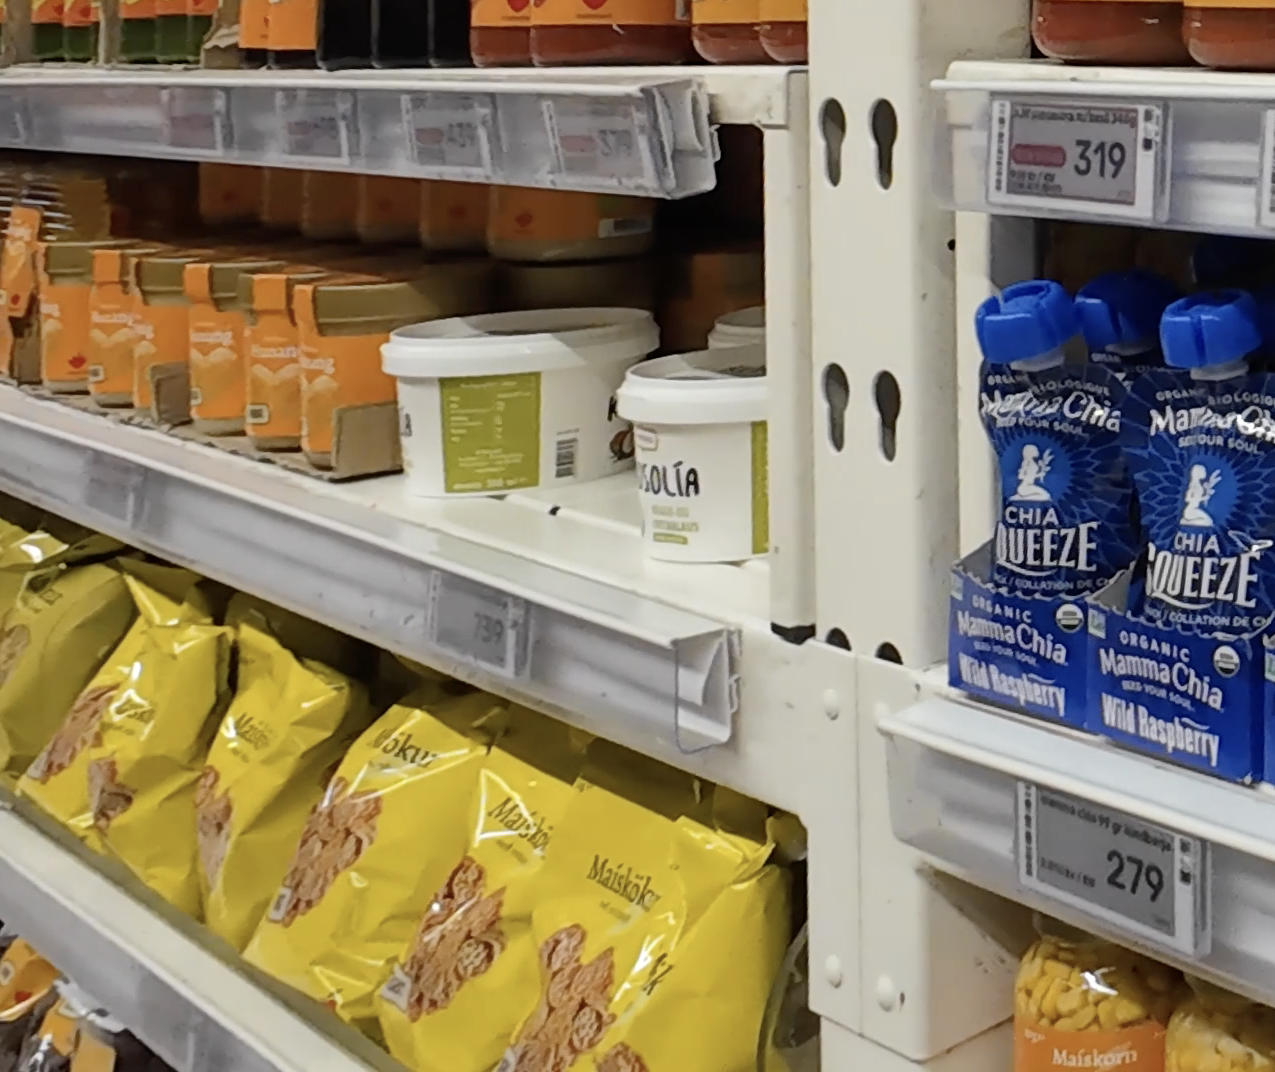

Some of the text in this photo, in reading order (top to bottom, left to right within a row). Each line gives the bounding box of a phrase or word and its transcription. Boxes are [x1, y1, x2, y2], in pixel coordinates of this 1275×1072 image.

[1073, 139, 1127, 180] 319
[1005, 505, 1059, 527] CHIA
[994, 520, 1099, 578] QUEEZE
[1173, 531, 1221, 556] CHIA
[971, 593, 1033, 625] ORGANIC
[1118, 630, 1191, 663] ORGANIC
[958, 652, 1067, 718] Wild Raspberry
[1101, 692, 1220, 768] Wild Raspberry
[1106, 848, 1165, 904] 279
[1050, 1042, 1139, 1071] Maískorn
